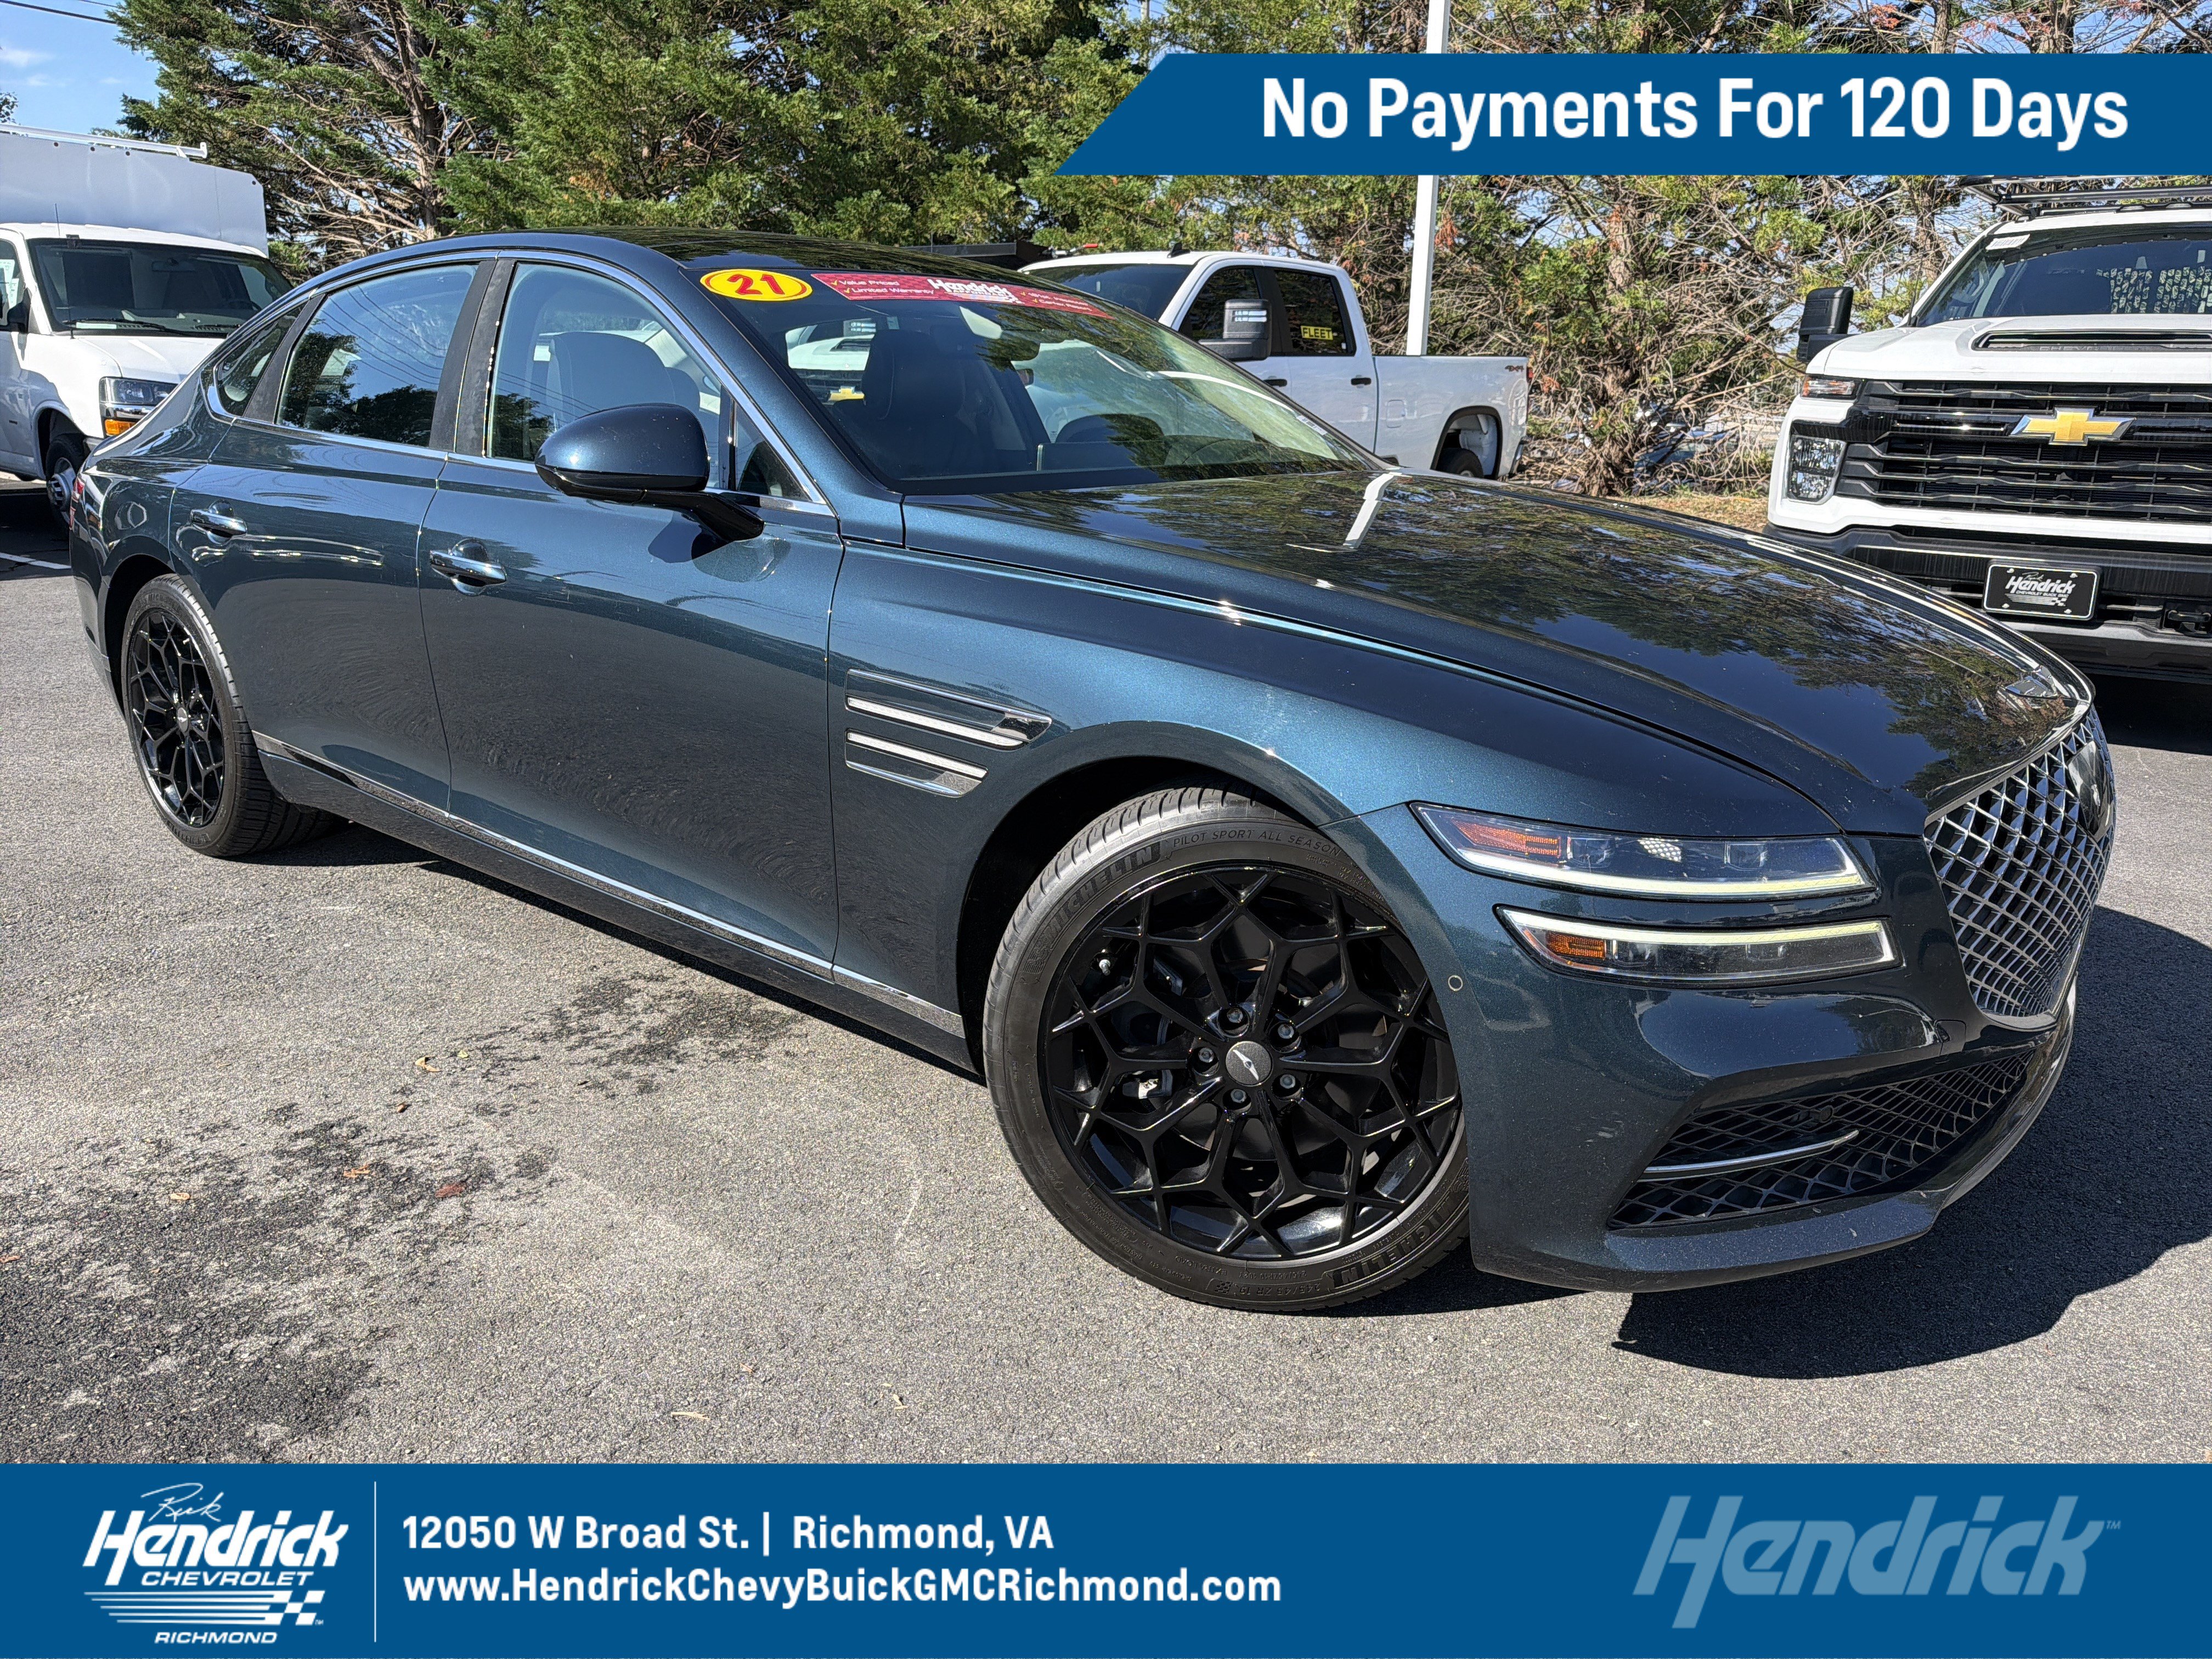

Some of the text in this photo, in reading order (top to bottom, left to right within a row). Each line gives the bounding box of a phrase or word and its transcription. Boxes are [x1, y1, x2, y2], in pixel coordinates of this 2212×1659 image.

[727, 274, 785, 295] 21
[927, 279, 1014, 296] Hendrick
[1302, 327, 1331, 338] FLEET
[2005, 575, 2076, 594] Hendrick
[1043, 830, 1342, 934] MICHELIN PILOT SPORT ALL SEASON
